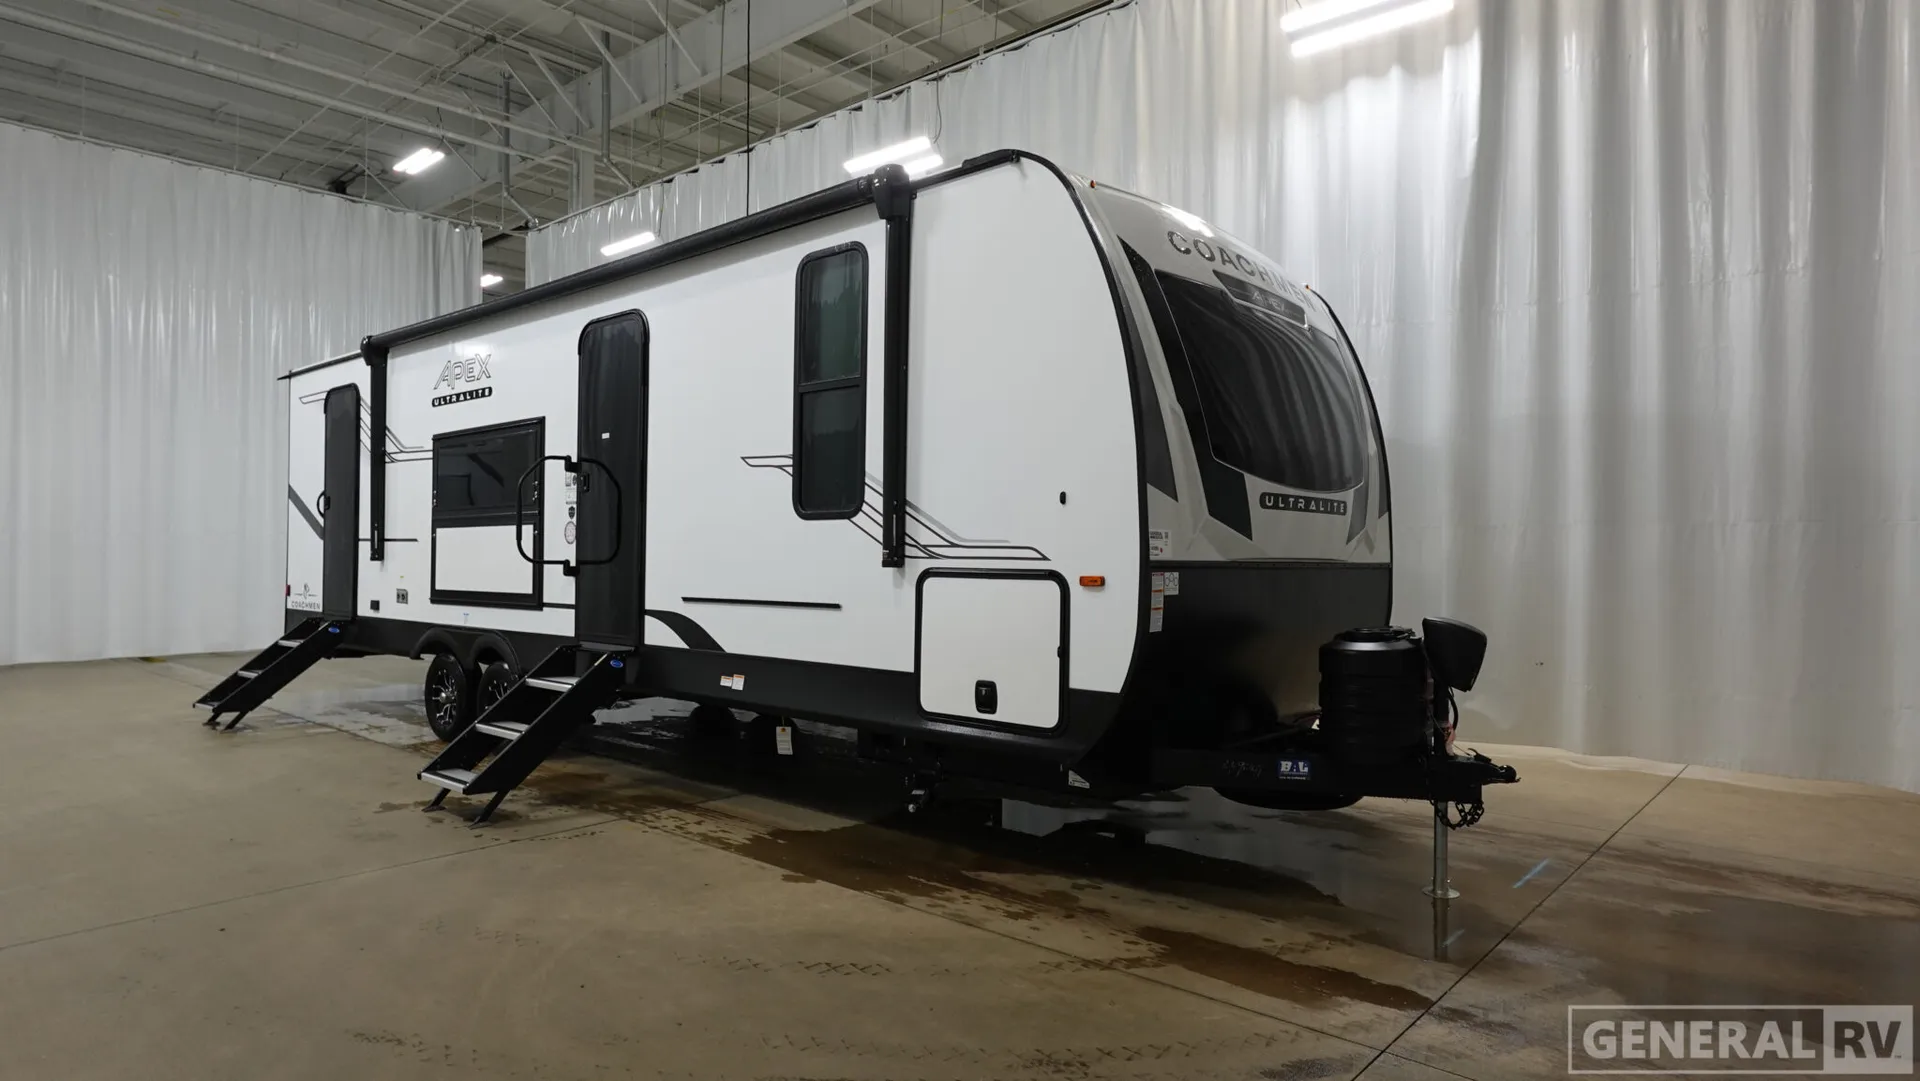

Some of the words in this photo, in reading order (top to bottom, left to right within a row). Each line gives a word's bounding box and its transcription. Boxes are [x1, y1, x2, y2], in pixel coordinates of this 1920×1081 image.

[1167, 230, 1317, 312] COACHMEN
[433, 353, 492, 390] APEX
[433, 388, 490, 406] ULTRALITE
[1265, 495, 1346, 514] ULTRALITE
